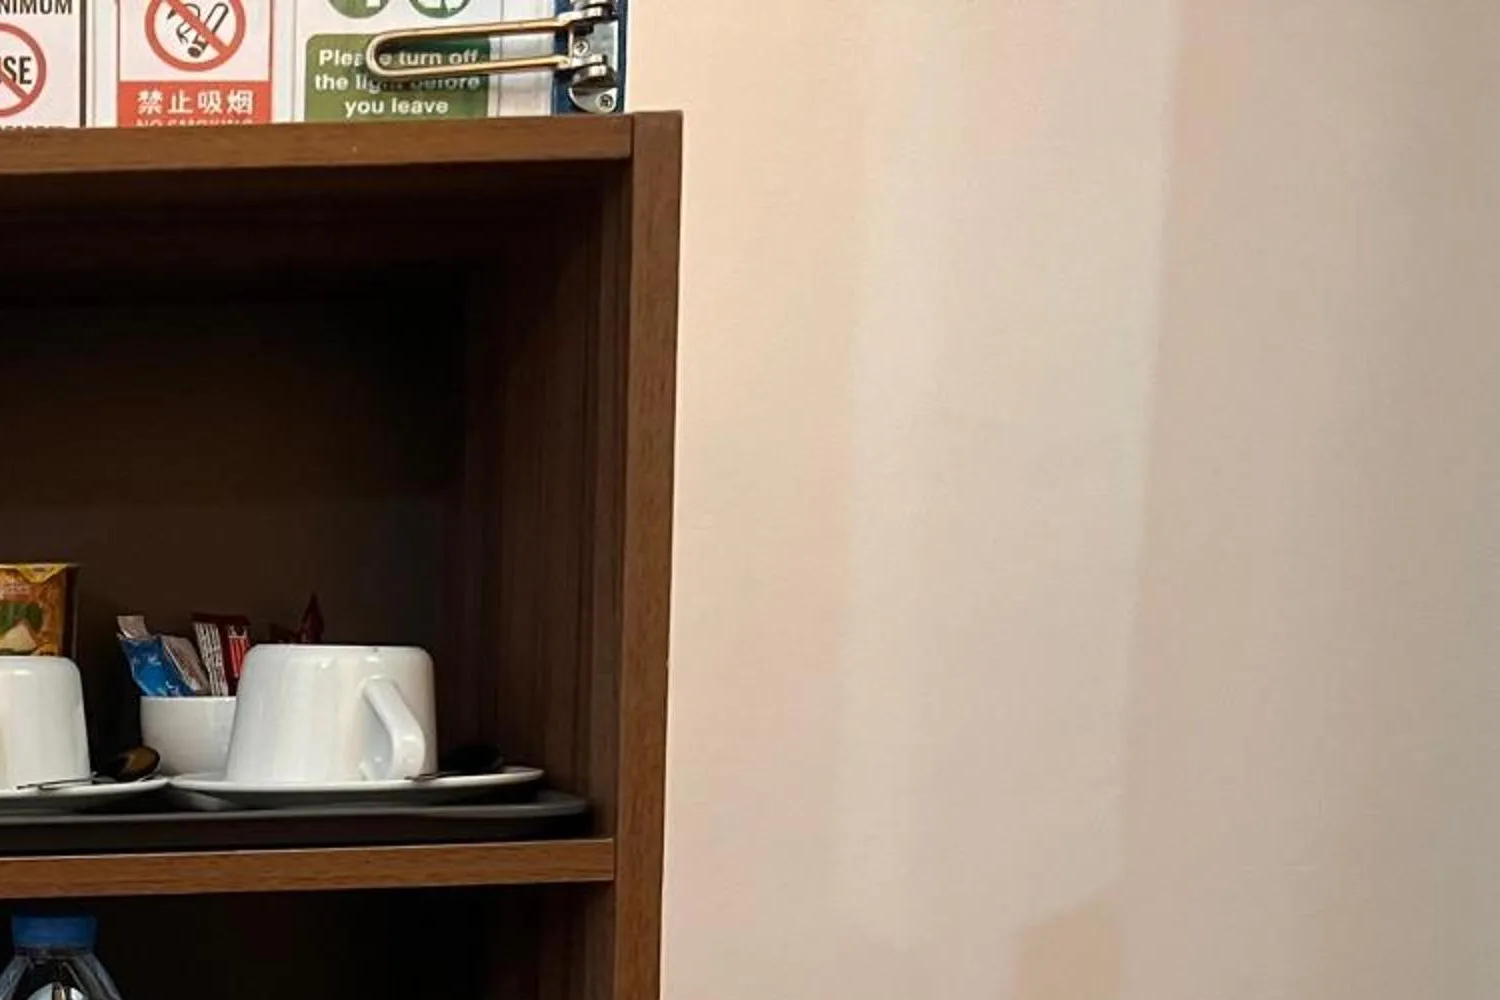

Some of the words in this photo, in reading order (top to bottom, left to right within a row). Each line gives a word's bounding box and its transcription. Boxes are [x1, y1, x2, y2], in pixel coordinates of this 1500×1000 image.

[319, 49, 392, 66] Pleae
[400, 51, 442, 65] turn
[450, 50, 479, 65] off
[315, 74, 348, 90] the
[356, 74, 403, 94] lig
[138, 89, 254, 115] 禁止吸烟
[345, 100, 384, 118] you
[391, 98, 449, 114] leave
